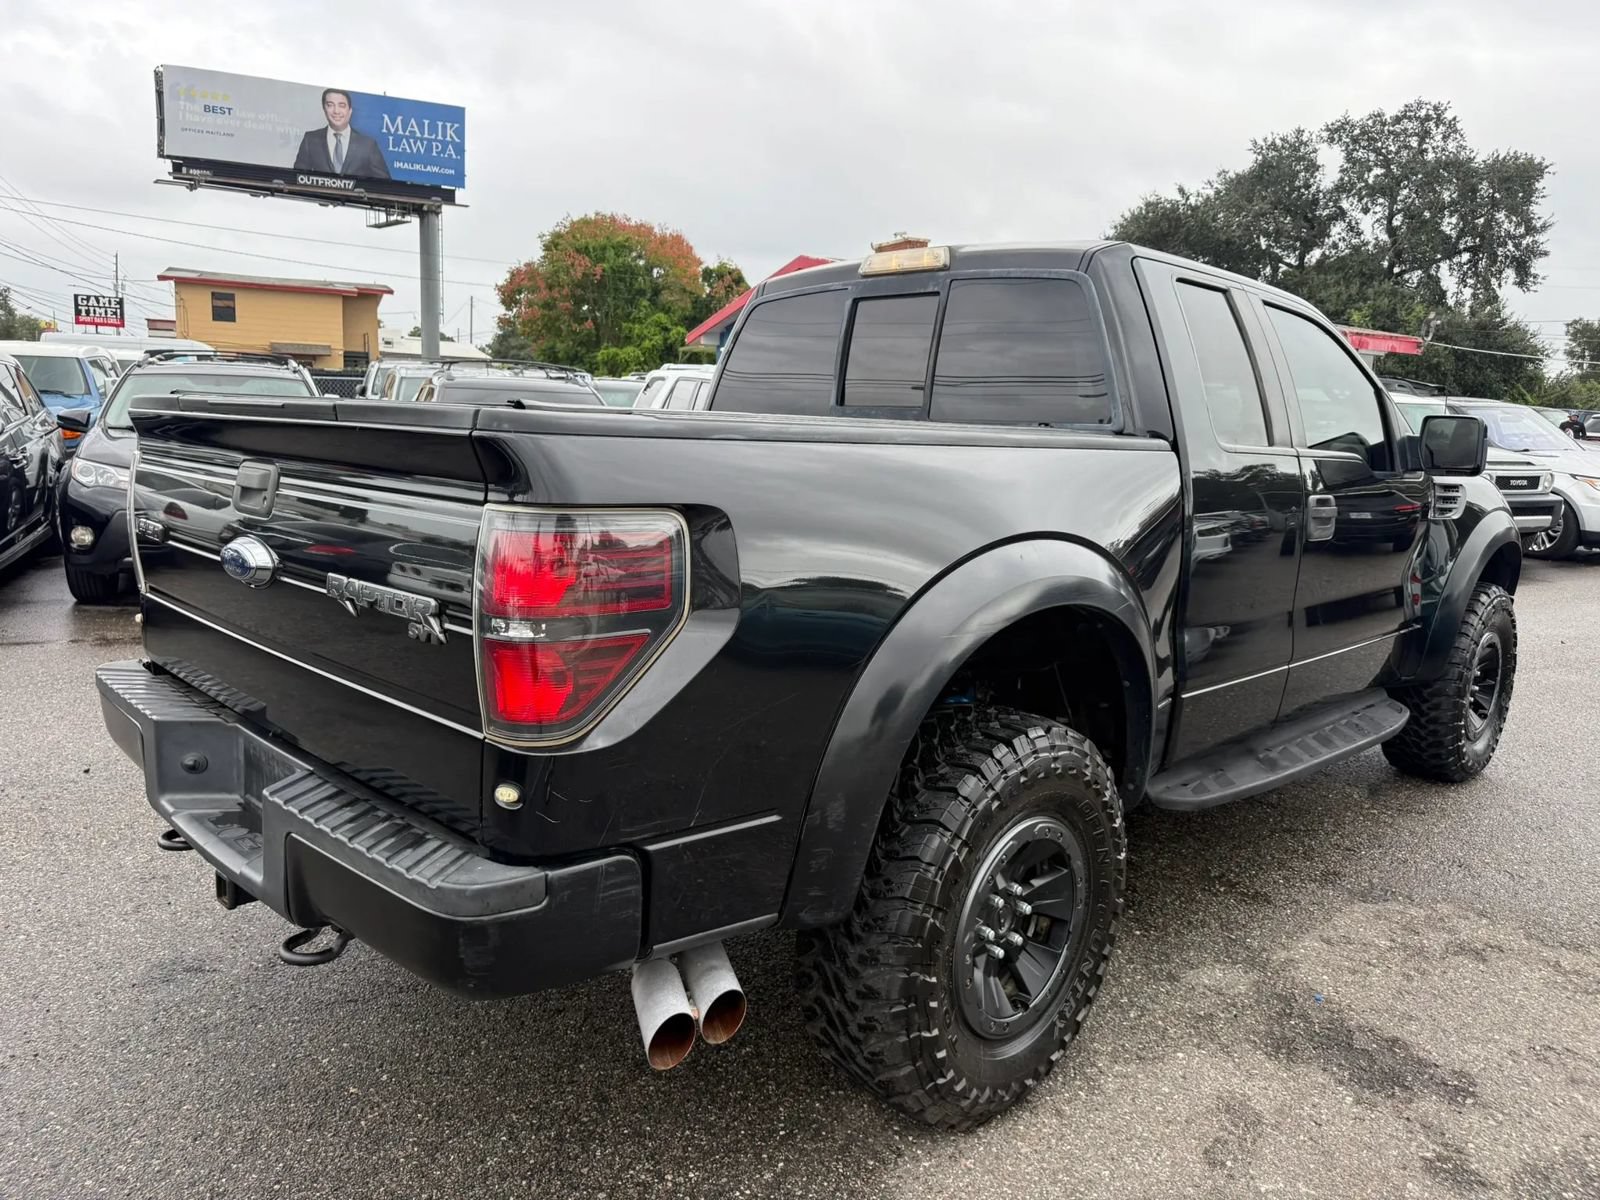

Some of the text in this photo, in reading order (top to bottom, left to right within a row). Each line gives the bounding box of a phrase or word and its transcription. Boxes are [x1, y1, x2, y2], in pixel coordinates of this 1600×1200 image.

[203, 104, 233, 116] BEST
[381, 113, 461, 142] MALIK
[388, 136, 461, 160] LAW P.A.
[77, 295, 121, 308] GAME
[78, 306, 121, 319] TIME!
[326, 572, 447, 641] RAPTOR
